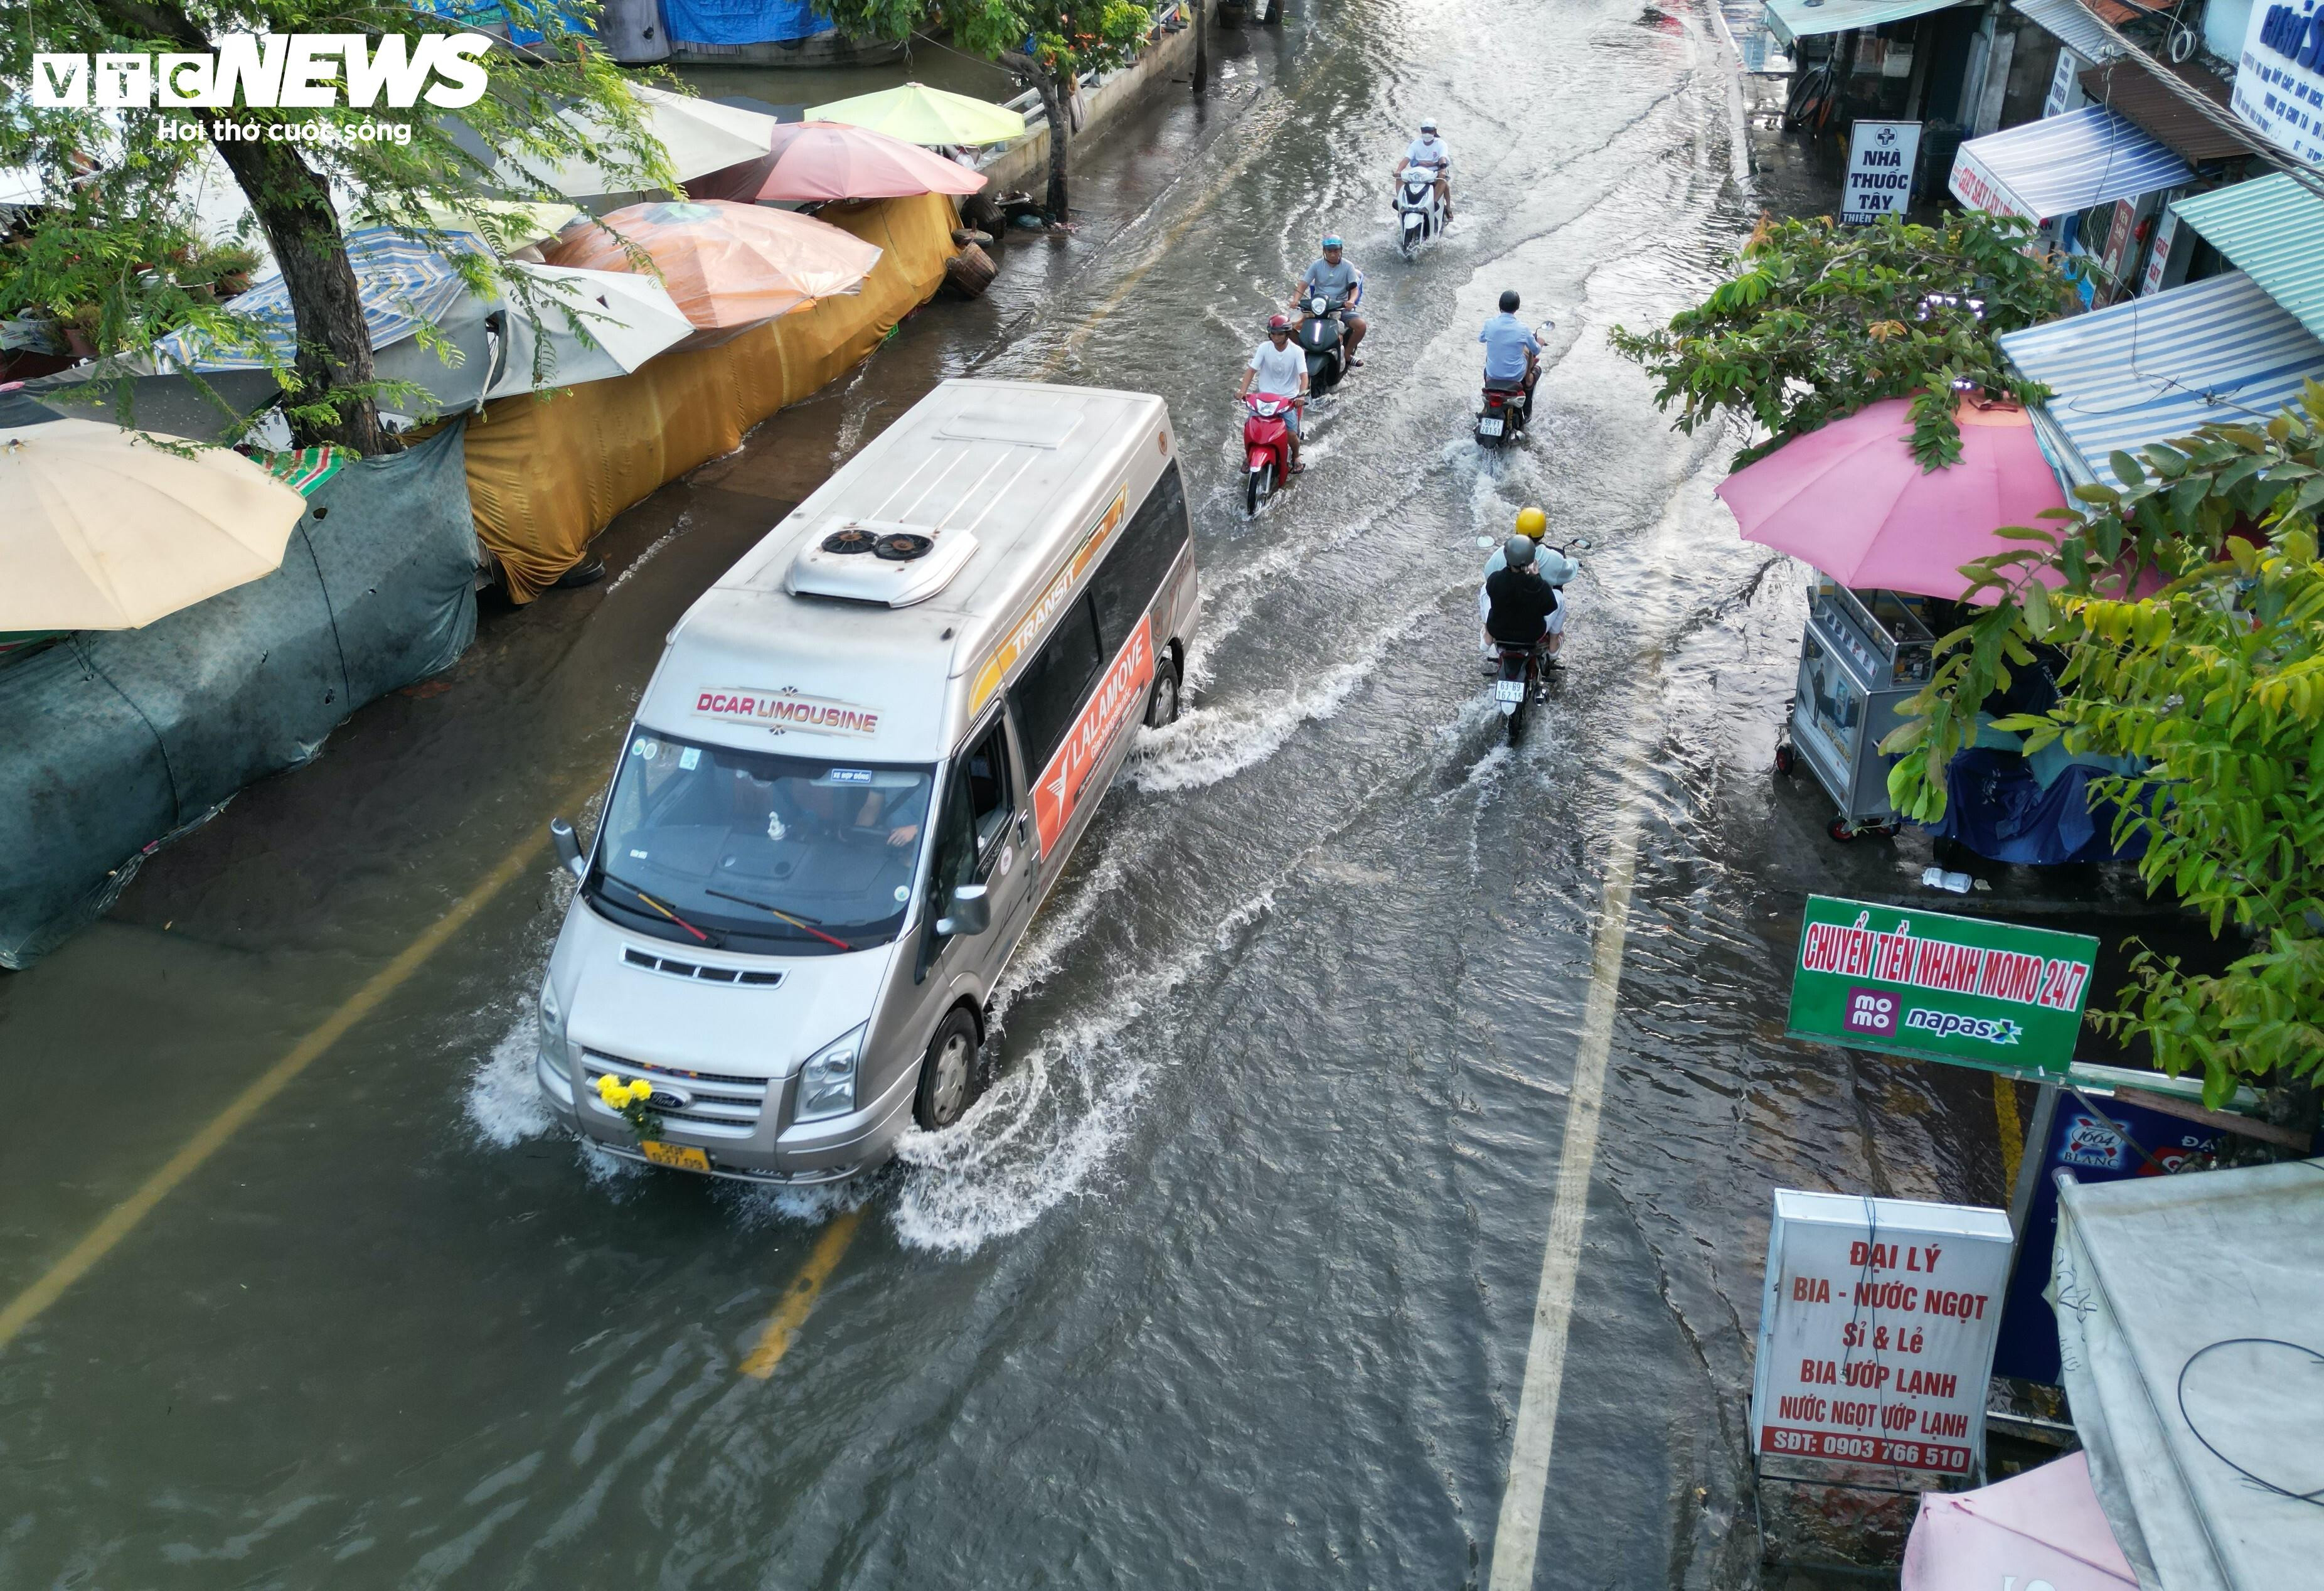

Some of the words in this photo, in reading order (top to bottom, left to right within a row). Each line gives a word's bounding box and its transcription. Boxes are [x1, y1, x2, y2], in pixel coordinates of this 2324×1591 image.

[2286, 105, 2300, 125] CHO
[1862, 148, 1901, 166] NHÀ
[1851, 168, 1909, 190] THUỐC
[1858, 191, 1894, 210] TÂY
[1012, 567, 1075, 655] TRANSIT
[696, 693, 755, 715] DCAR
[757, 699, 878, 733] LIMOUSINE
[1072, 633, 1143, 771] LALAMOVE
[1803, 911, 1875, 977] CHUYỂN
[1875, 921, 1917, 982] TIỀN
[1915, 940, 1983, 994] NHANH
[1978, 950, 2042, 1002] MOMO
[2039, 960, 2089, 1010] 24/7
[1852, 1010, 1890, 1029] mo
[1855, 995, 1892, 1013] mo
[1906, 1009, 1992, 1037] napas
[2077, 1129, 2117, 1147] 1664
[2063, 1151, 2120, 1169] BLANC
[1850, 1241, 1899, 1274] ĐẠI
[1906, 1243, 1942, 1273] LÝ
[1793, 1277, 1830, 1304] BIA
[1853, 1280, 1918, 1312] NƯỚC
[1924, 1289, 1989, 1324] NGỌT
[1842, 1320, 1867, 1348] Sỉ
[1873, 1326, 1890, 1351] &
[1897, 1326, 1924, 1354] Lẻ
[1800, 1359, 1836, 1385] BIA
[1845, 1359, 1890, 1390] ƯỚP
[1895, 1368, 1958, 1400] LẠNH
[1779, 1393, 1827, 1423] NƯỚC
[1830, 1400, 1878, 1432] NGỌT
[1880, 1401, 1917, 1432] ƯỚP
[1921, 1410, 1969, 1441] LẠNH
[1773, 1430, 1818, 1452] SĐT:
[1823, 1435, 1875, 1458] 0903
[1880, 1441, 1921, 1464] 766
[1925, 1447, 1965, 1467] 510
